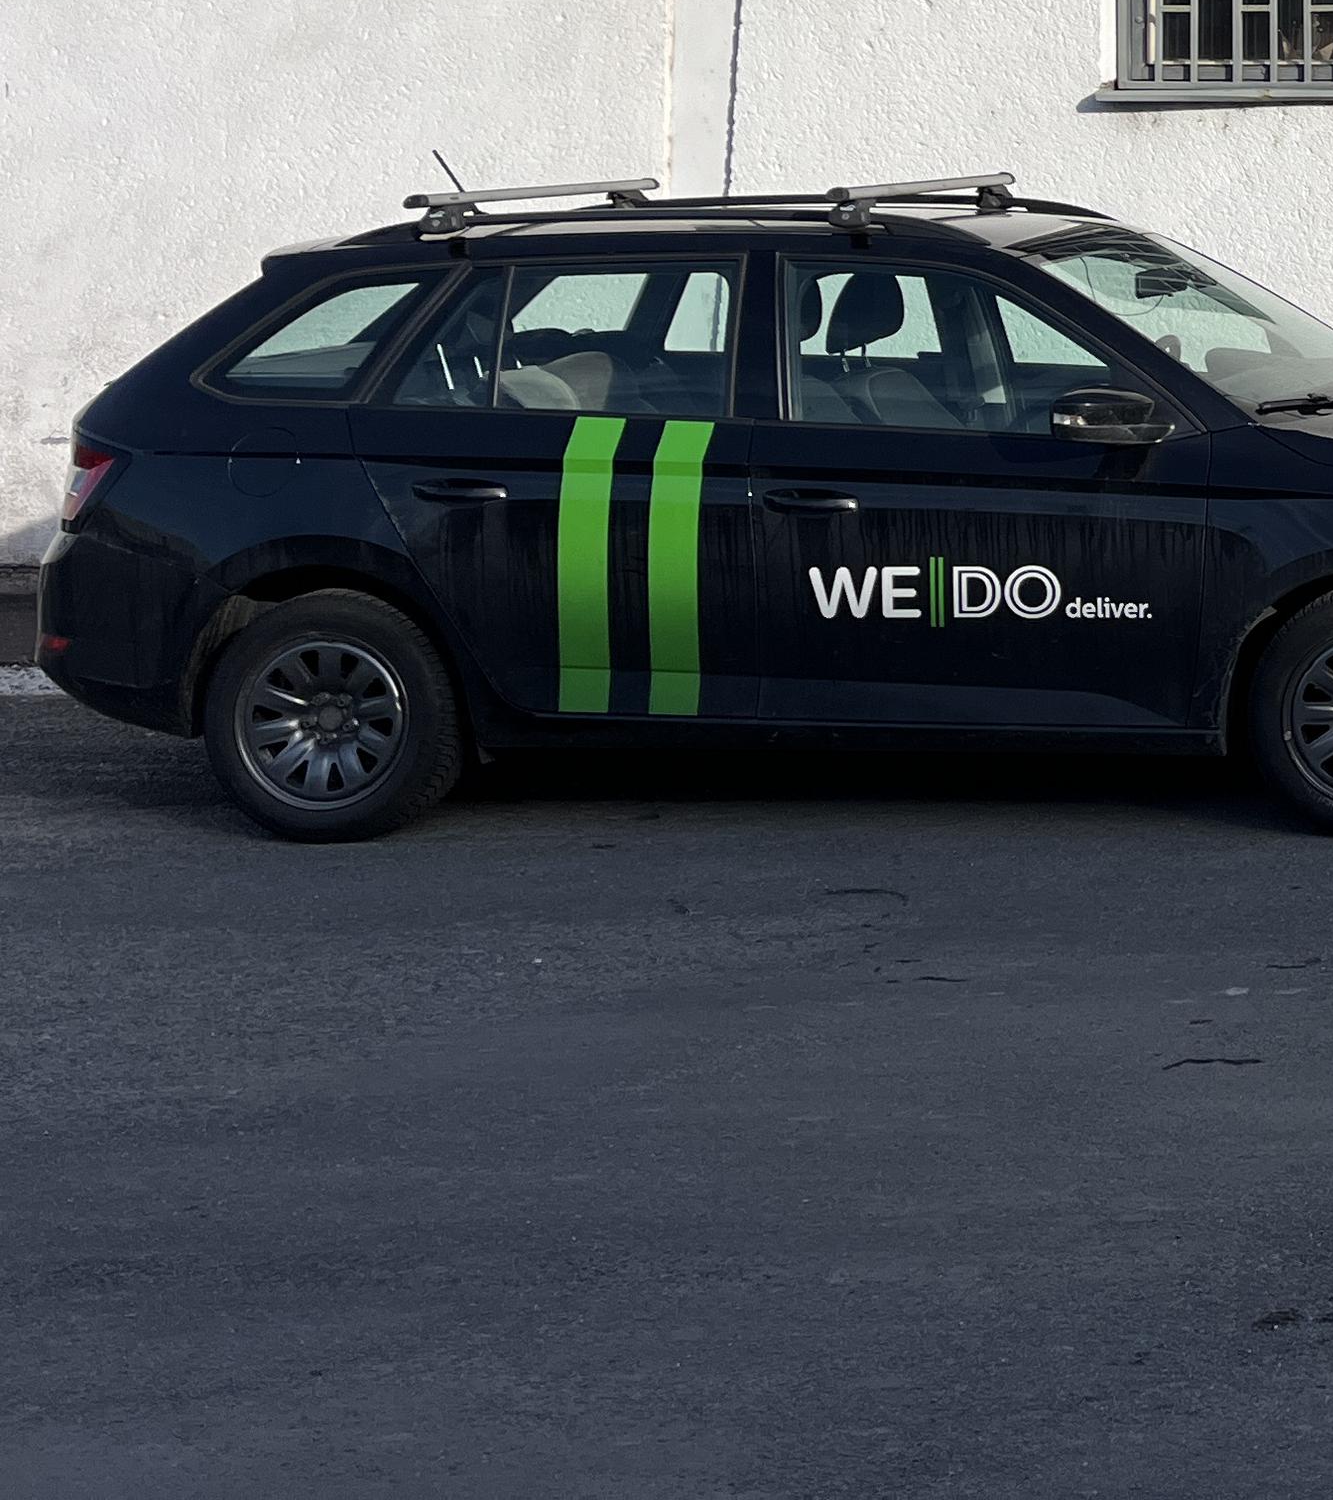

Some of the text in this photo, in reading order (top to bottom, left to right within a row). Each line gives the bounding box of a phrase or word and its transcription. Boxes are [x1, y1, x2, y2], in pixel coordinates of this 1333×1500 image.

[808, 564, 1153, 619] WE DO deliver.
